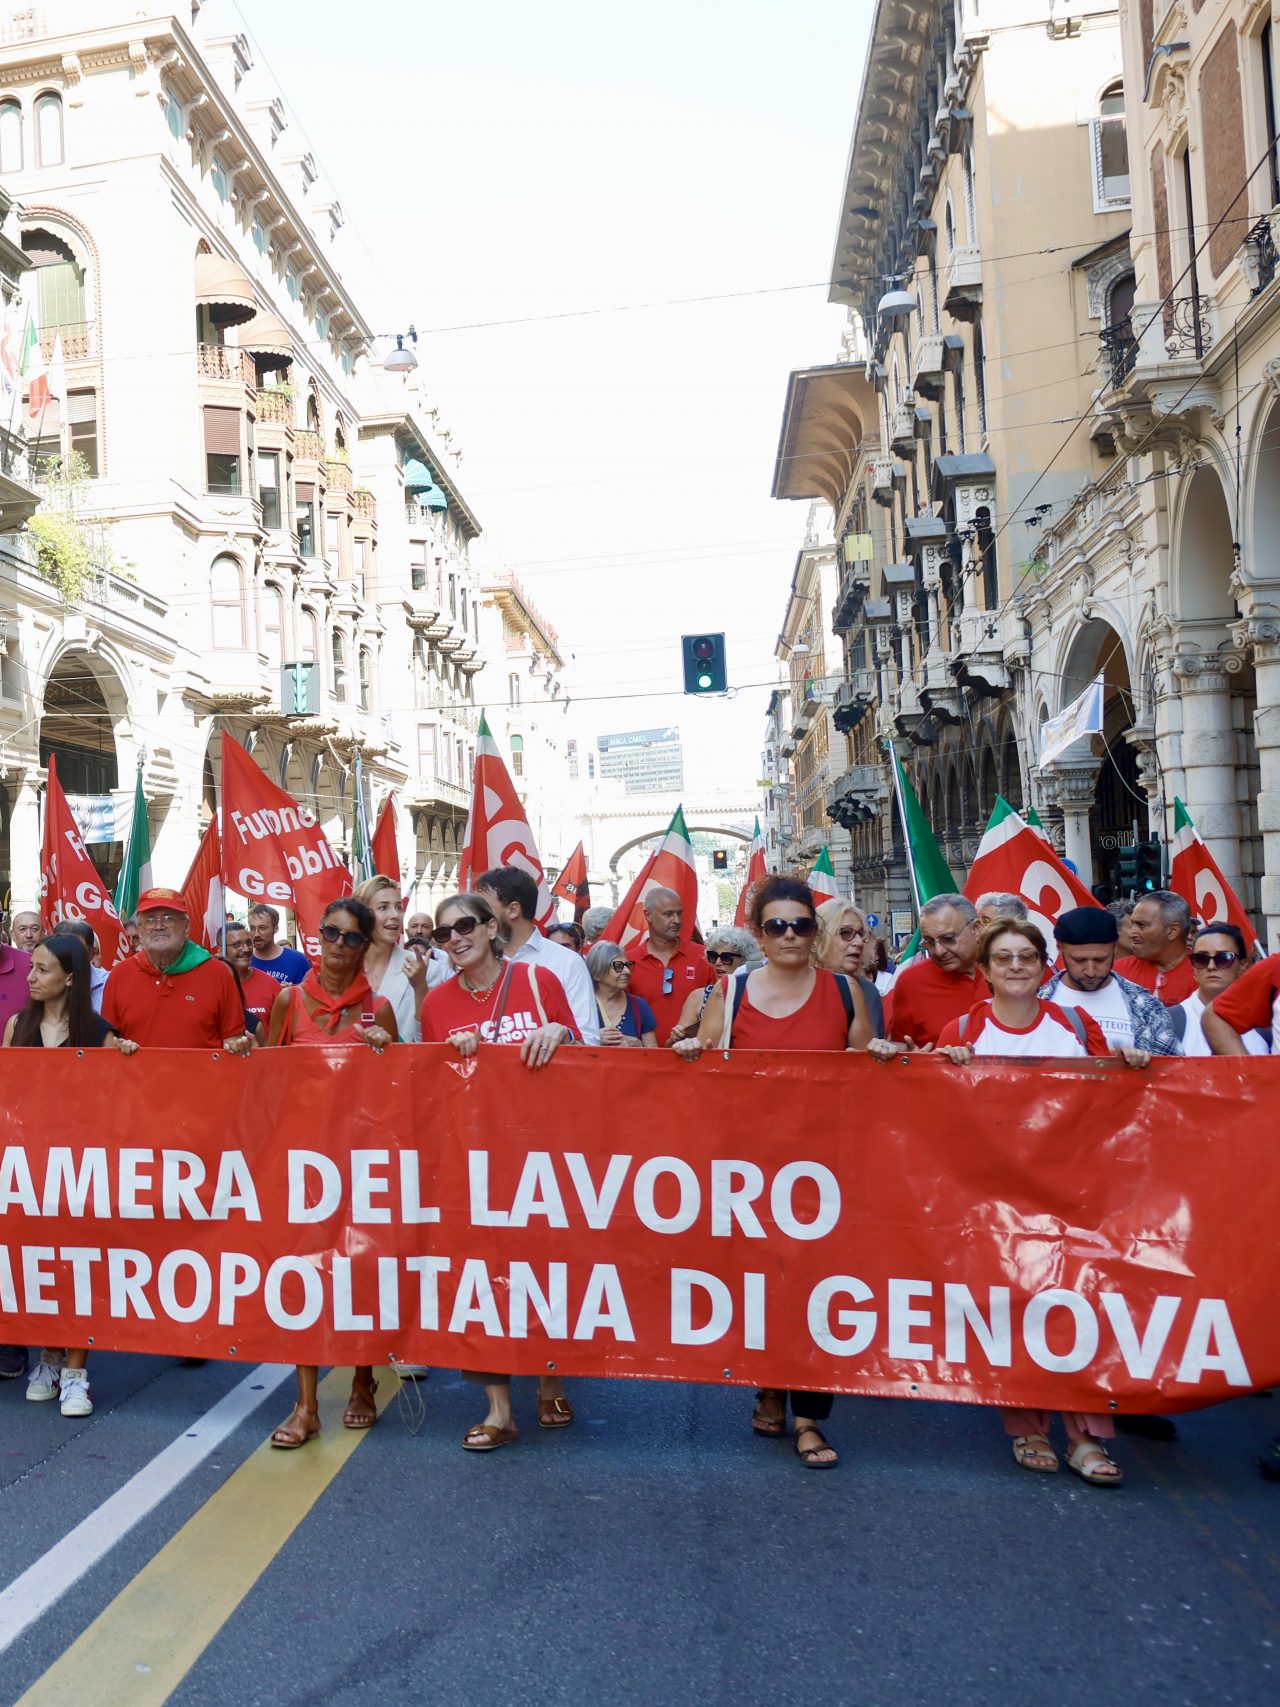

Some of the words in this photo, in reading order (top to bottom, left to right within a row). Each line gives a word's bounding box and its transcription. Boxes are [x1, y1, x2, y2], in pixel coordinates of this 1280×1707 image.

[287, 1149, 441, 1225] DEL
[468, 1149, 841, 1241] LAVORO
[670, 1267, 767, 1351] DI
[806, 1274, 1254, 1387] GENOVA
